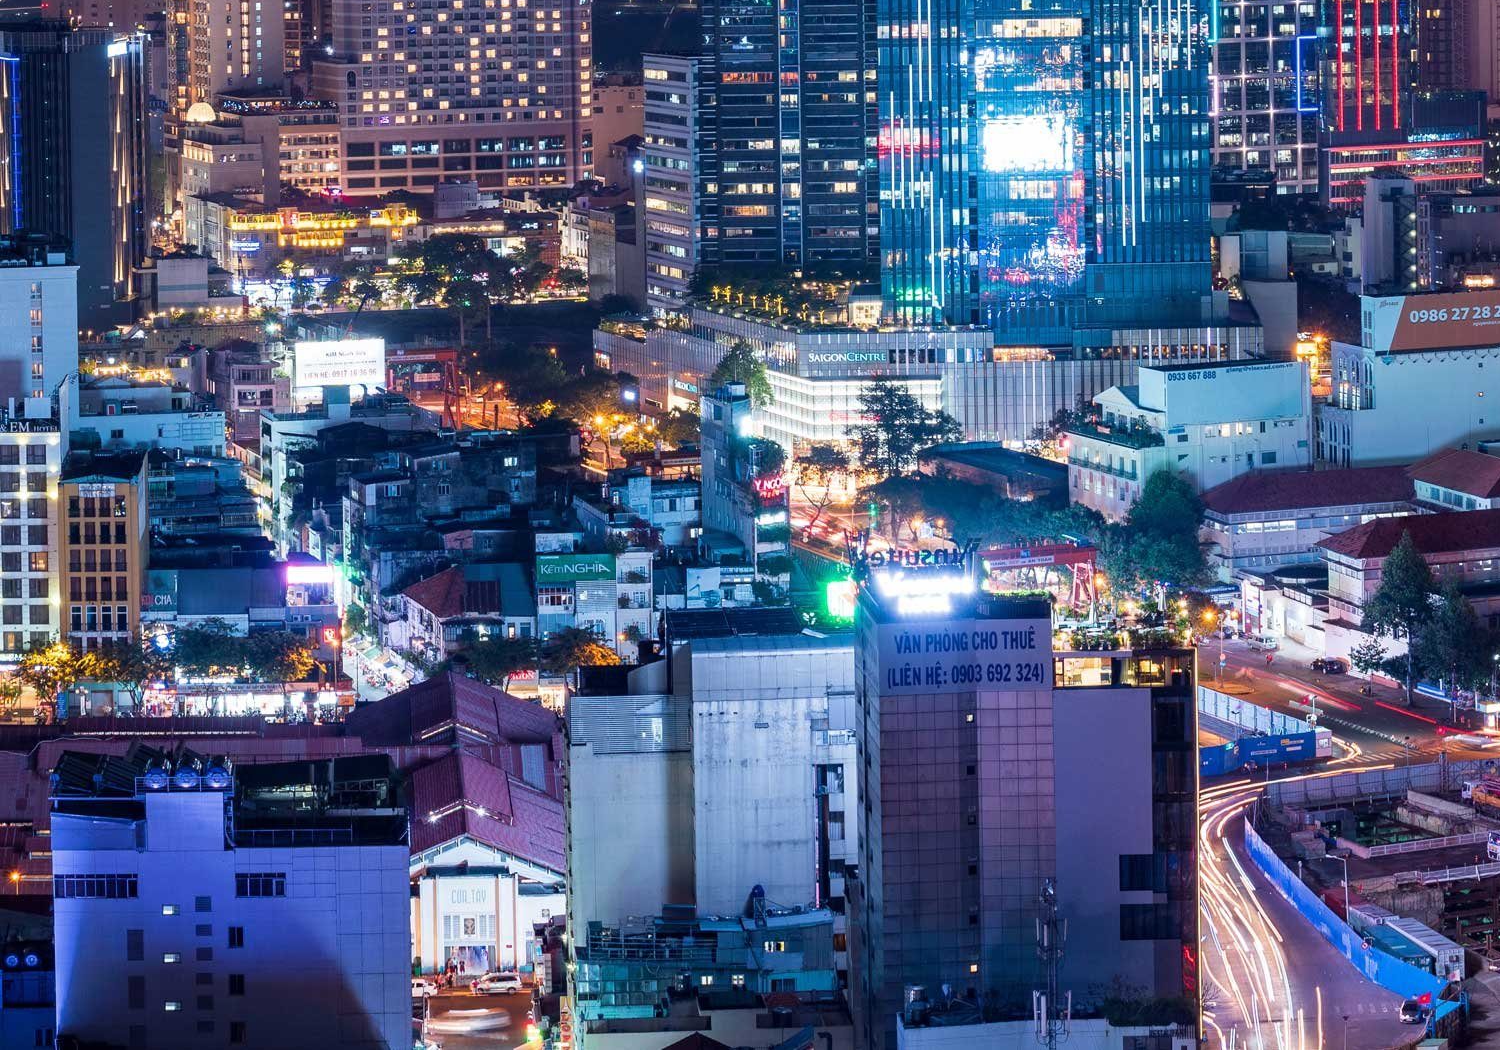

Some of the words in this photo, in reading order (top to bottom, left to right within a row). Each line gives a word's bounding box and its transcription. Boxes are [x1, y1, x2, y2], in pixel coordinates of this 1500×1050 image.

[1409, 309, 1448, 324] 0986
[1451, 307, 1470, 321] 27
[1472, 306, 1492, 320] 28
[1167, 372, 1186, 382] 0933
[1188, 371, 1201, 381] 667
[1203, 370, 1217, 380] 888
[10, 421, 30, 432] EM
[33, 425, 58, 433] HOTEL
[894, 631, 921, 655] VĂN
[925, 627, 969, 653] PHÒNG
[971, 630, 998, 650] CHO
[1001, 625, 1036, 650] THUÊ
[887, 662, 922, 689] (LIÊN
[925, 661, 948, 689] HỆ:
[951, 664, 982, 684] 0903
[986, 663, 1011, 682] 692
[1015, 662, 1044, 684] 324)
